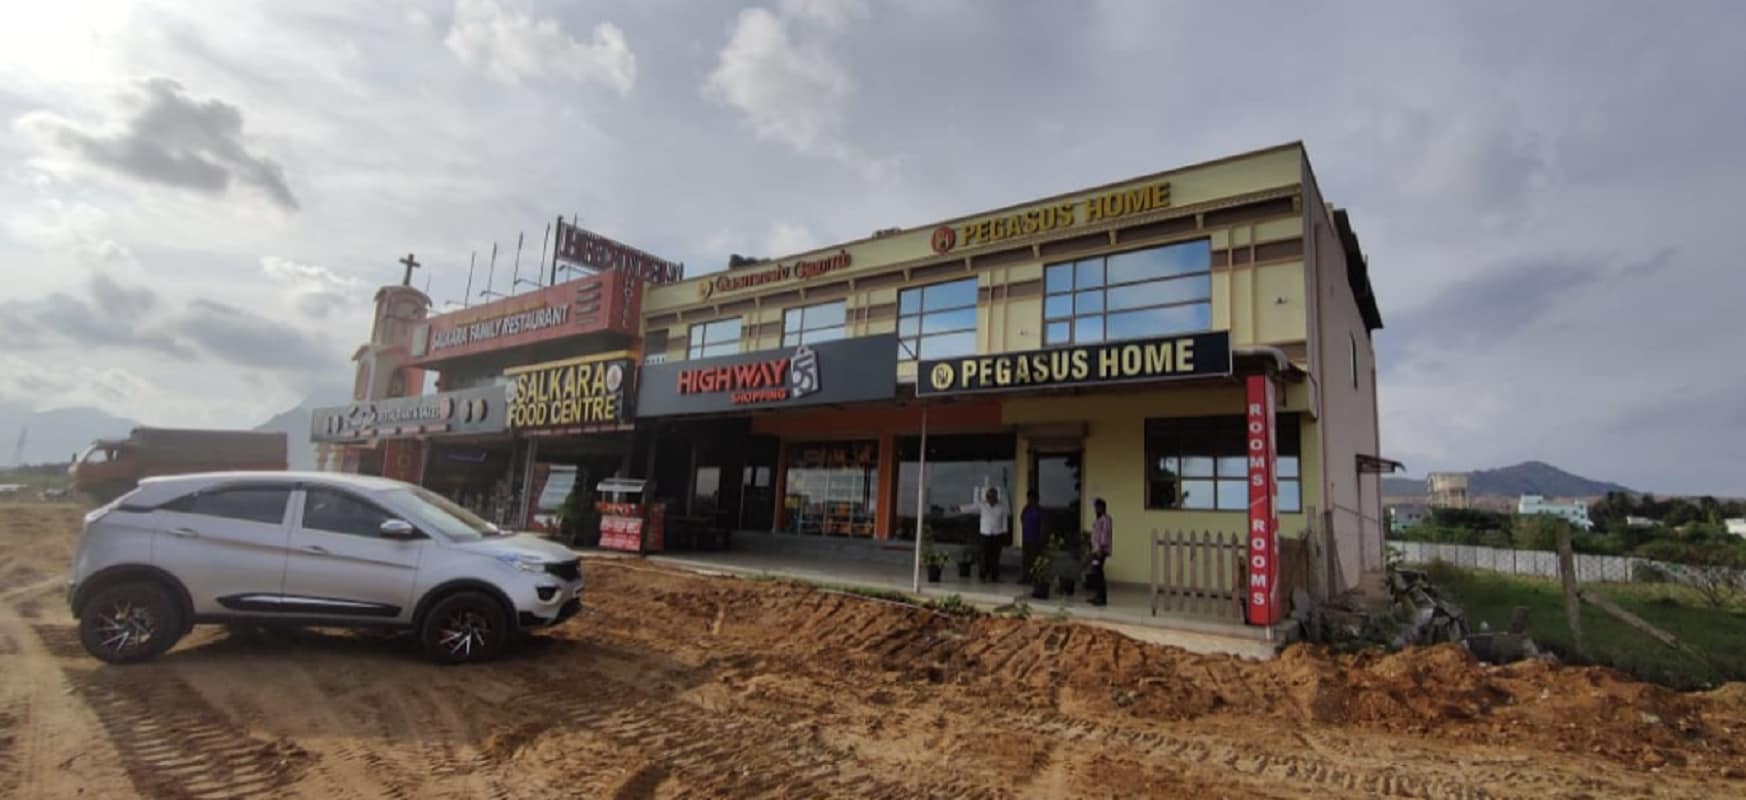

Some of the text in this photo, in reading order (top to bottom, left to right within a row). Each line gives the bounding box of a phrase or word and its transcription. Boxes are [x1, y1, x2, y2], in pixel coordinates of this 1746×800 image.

[961, 182, 1171, 246] PEGASUS HOME
[469, 319, 503, 343] FAMILY
[502, 304, 569, 334] RESTAURANT
[516, 361, 606, 404] SALKARA
[678, 361, 788, 393] HIGHWAY
[961, 339, 1195, 388] PEGASUS HOME
[506, 394, 617, 429] FOOD CENTRE
[730, 387, 787, 404] SHOPPING
[1249, 403, 1265, 487] ROOMS
[1251, 519, 1266, 606] ROOMS
